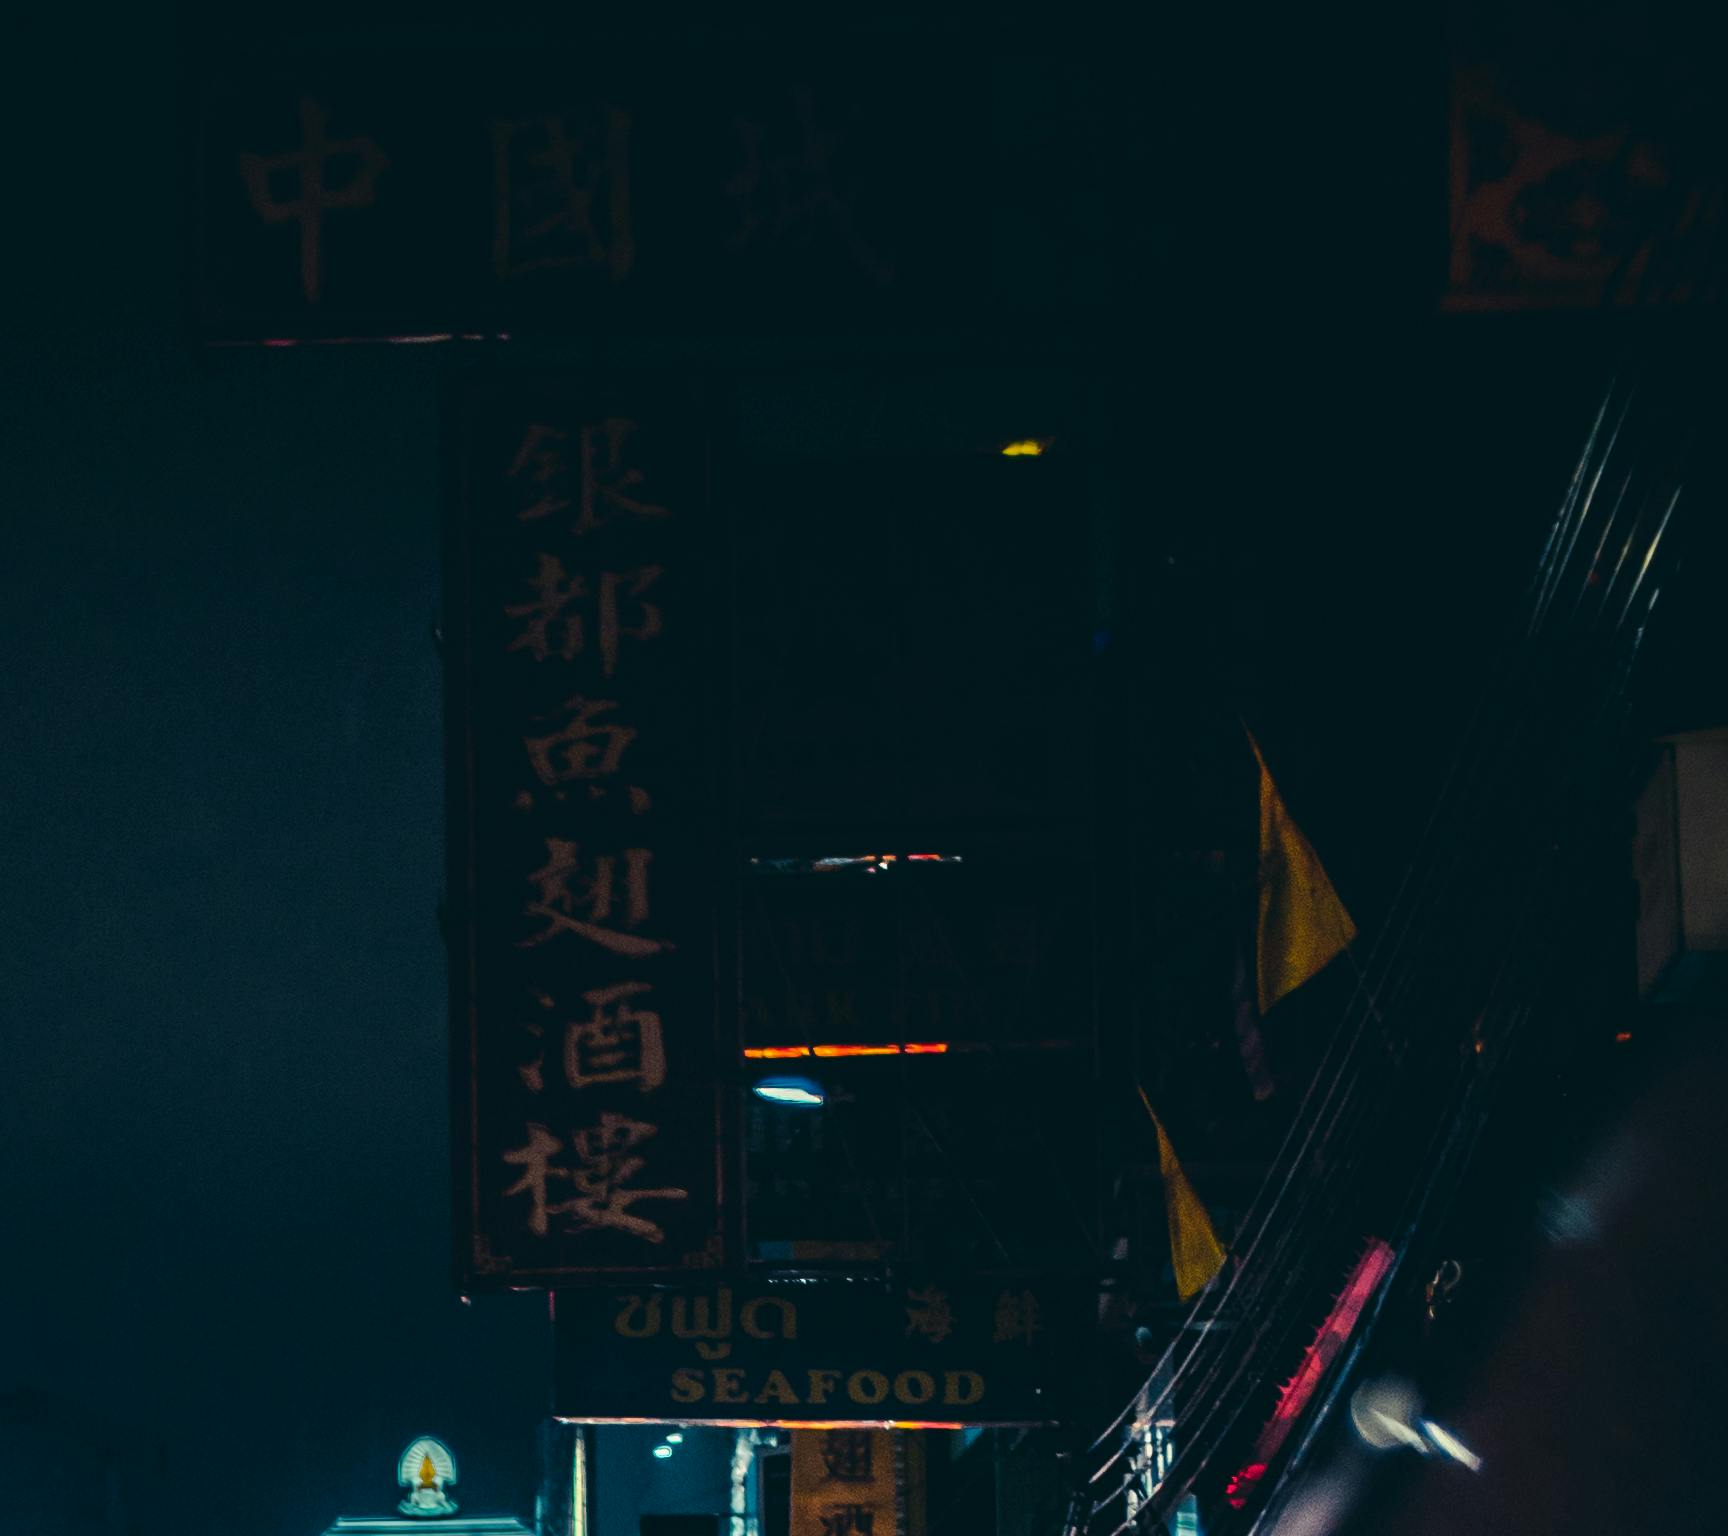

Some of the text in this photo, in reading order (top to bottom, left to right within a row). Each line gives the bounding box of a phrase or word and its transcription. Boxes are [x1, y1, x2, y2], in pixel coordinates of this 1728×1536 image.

[501, 417, 688, 1243] 銀都魚翅酒樓
[671, 1367, 987, 1405] SEAFOOD
